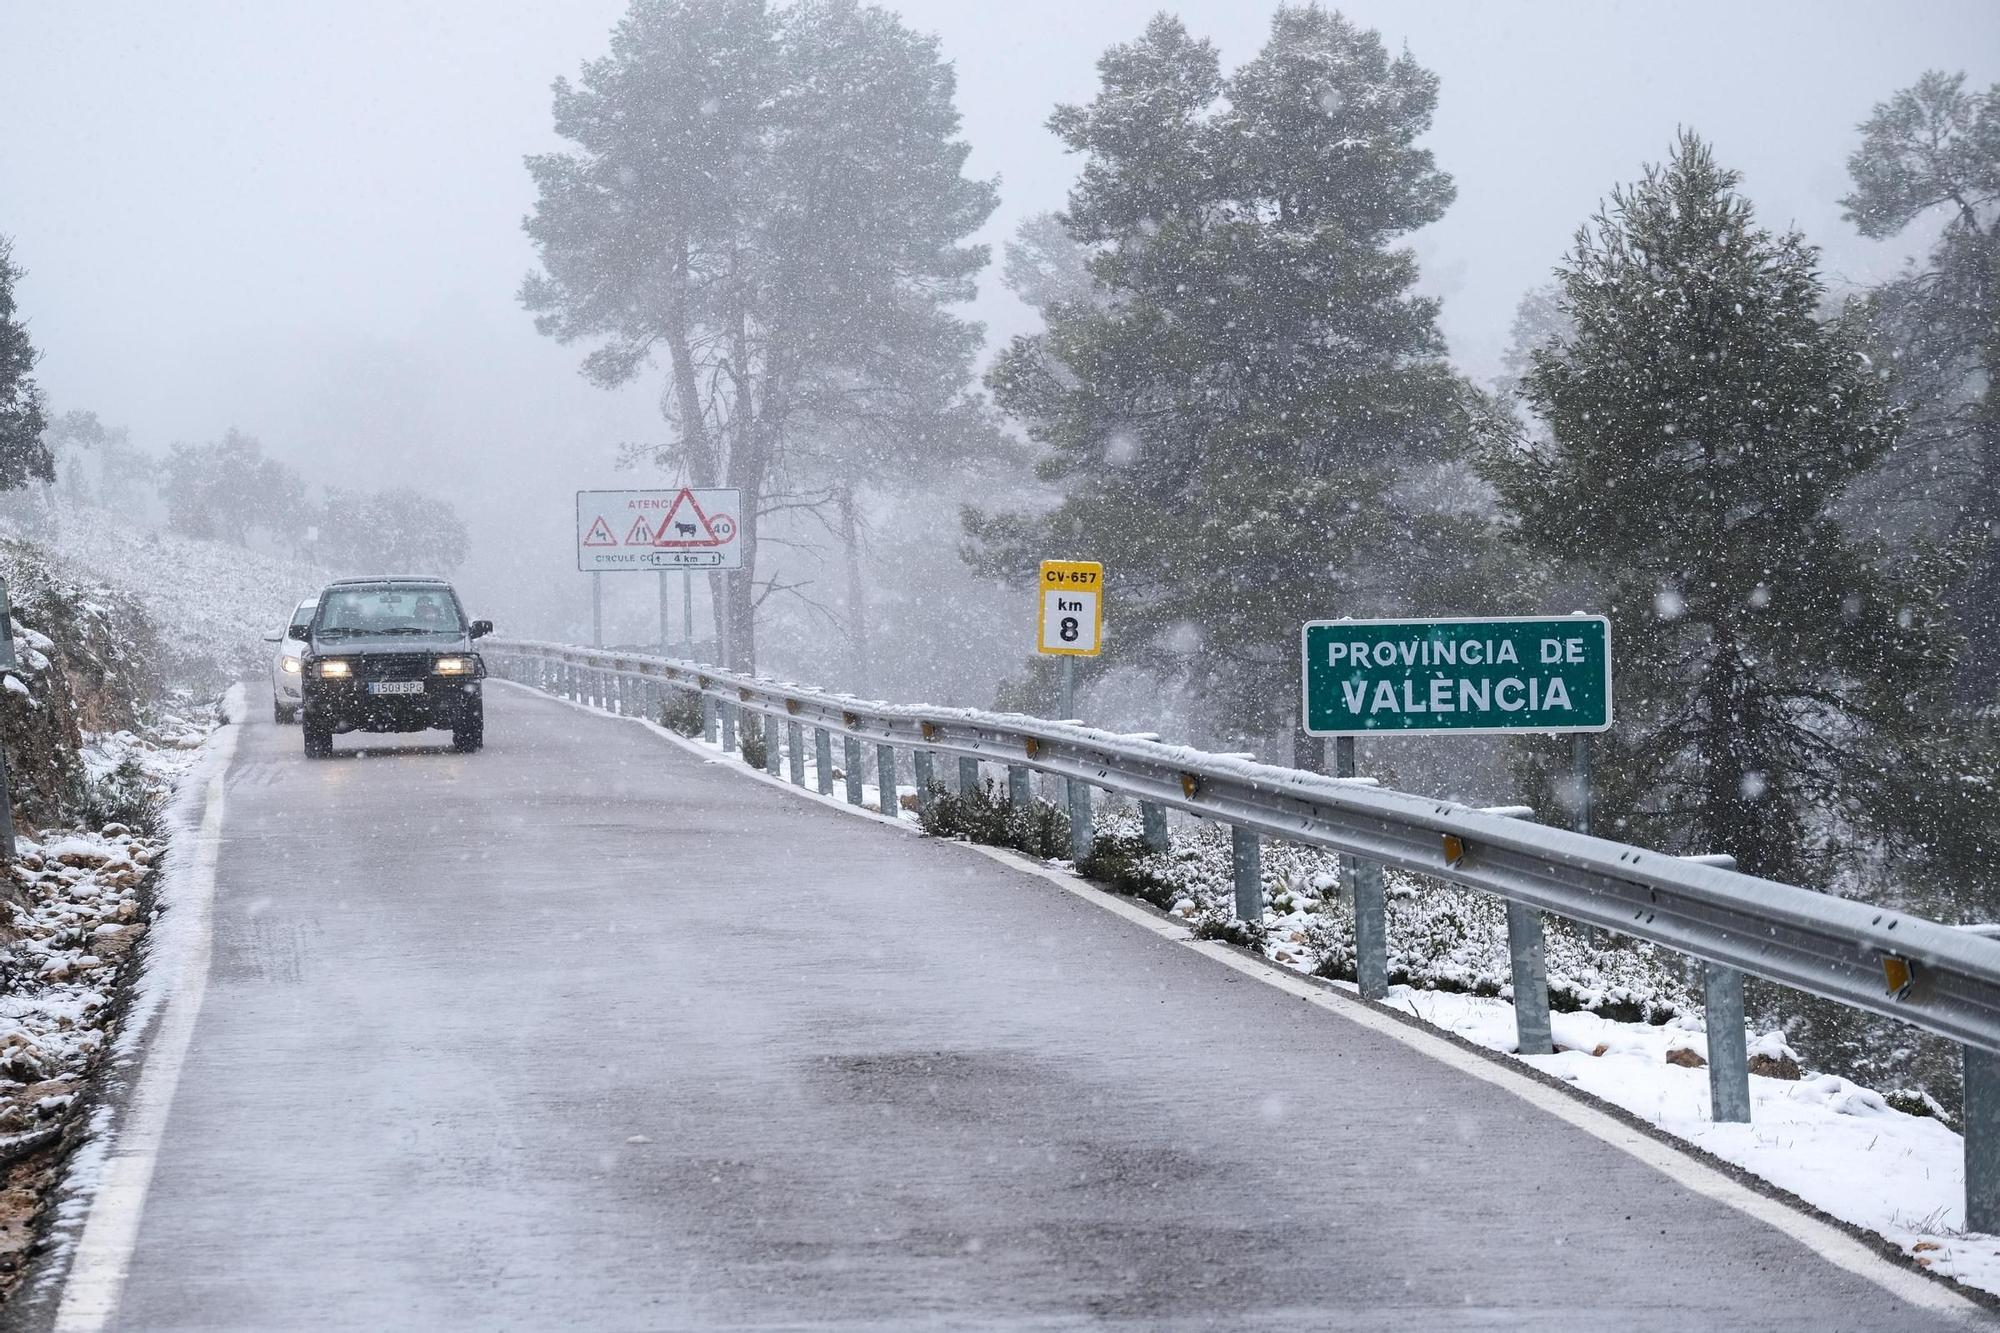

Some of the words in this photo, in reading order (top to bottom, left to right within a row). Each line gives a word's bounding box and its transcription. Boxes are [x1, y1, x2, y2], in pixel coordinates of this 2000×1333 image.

[628, 499, 672, 509] ATENCI
[709, 523, 731, 534] 40
[595, 554, 635, 563] CIRCULE
[640, 554, 653, 562] CO
[673, 554, 681, 562] 4
[684, 555, 698, 563] km
[1046, 571, 1097, 583] CV-657
[1058, 597, 1082, 611] km
[1059, 617, 1079, 642] 8
[1328, 639, 1519, 668] PROVINCIA
[1540, 638, 1586, 664] DE
[1341, 672, 1574, 714] VALÈNCIA
